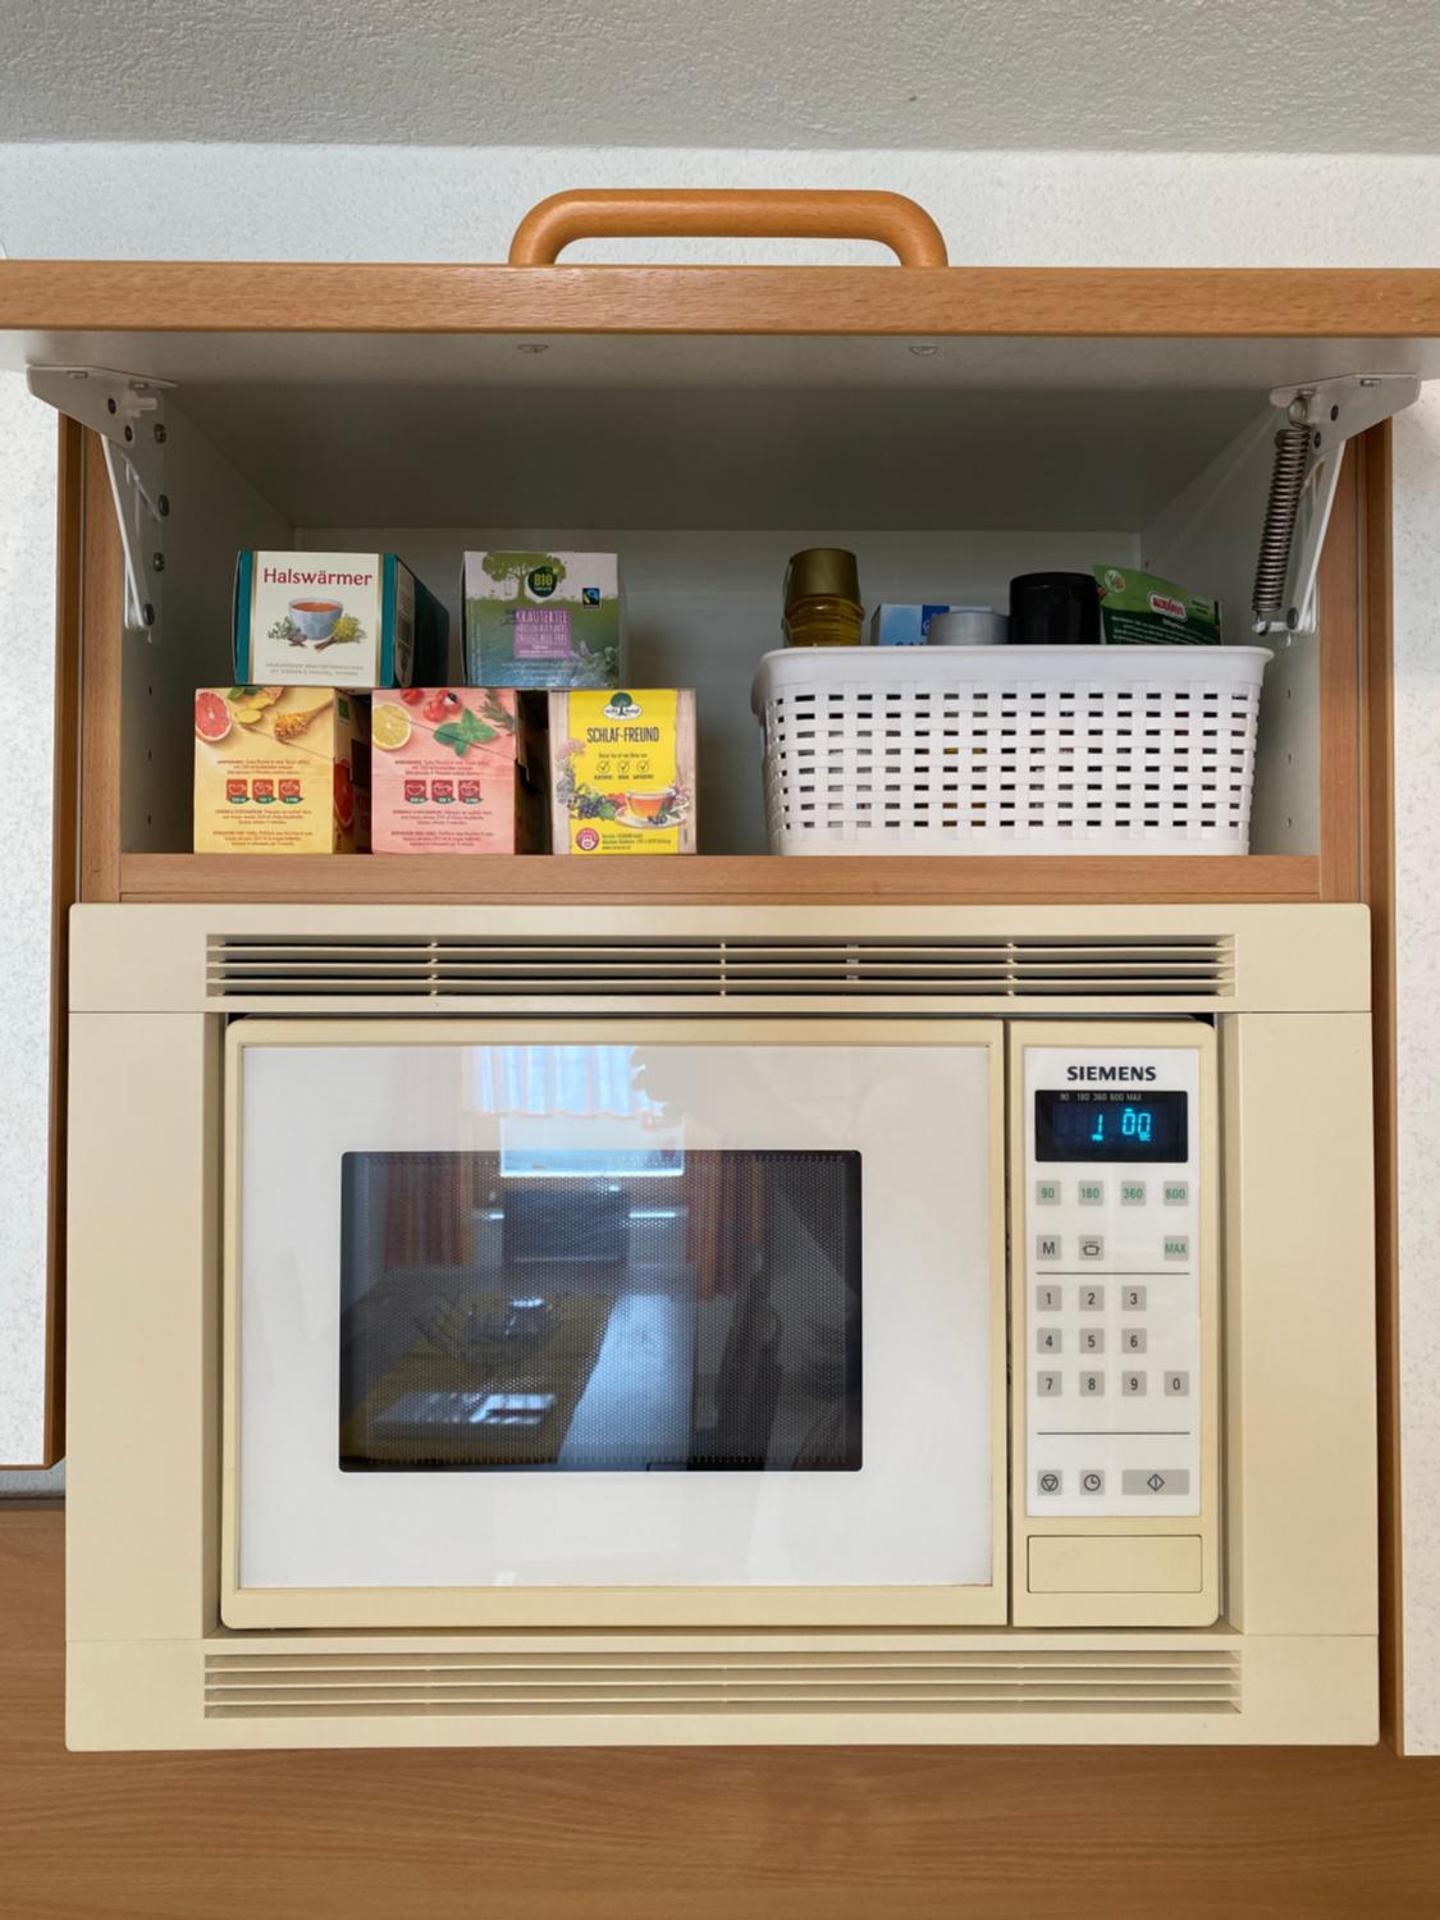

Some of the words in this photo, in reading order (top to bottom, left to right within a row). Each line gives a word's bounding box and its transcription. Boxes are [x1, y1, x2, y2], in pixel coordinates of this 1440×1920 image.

[263, 567, 373, 586] Halswärmer
[534, 573, 553, 586] BIO
[587, 727, 660, 743] SCHLAF-FREUND
[1067, 1066, 1156, 1081] SIEMENS
[1127, 1093, 1142, 1101] MAX
[1041, 1187, 1055, 1199] 90
[1081, 1187, 1099, 1199] 180
[1123, 1187, 1143, 1199] 360
[1165, 1187, 1186, 1199] 600
[1043, 1242, 1055, 1254] M
[1165, 1243, 1186, 1254] MAX
[1046, 1293, 1053, 1305] 1
[1087, 1293, 1096, 1305] 2
[1130, 1293, 1138, 1305] 3
[1045, 1335, 1053, 1347] 4
[1087, 1335, 1096, 1347] 5
[1130, 1335, 1138, 1347] 6
[1045, 1378, 1053, 1390] 7
[1087, 1378, 1096, 1390] 8
[1130, 1378, 1138, 1390] 9
[1172, 1378, 1181, 1390] 0
